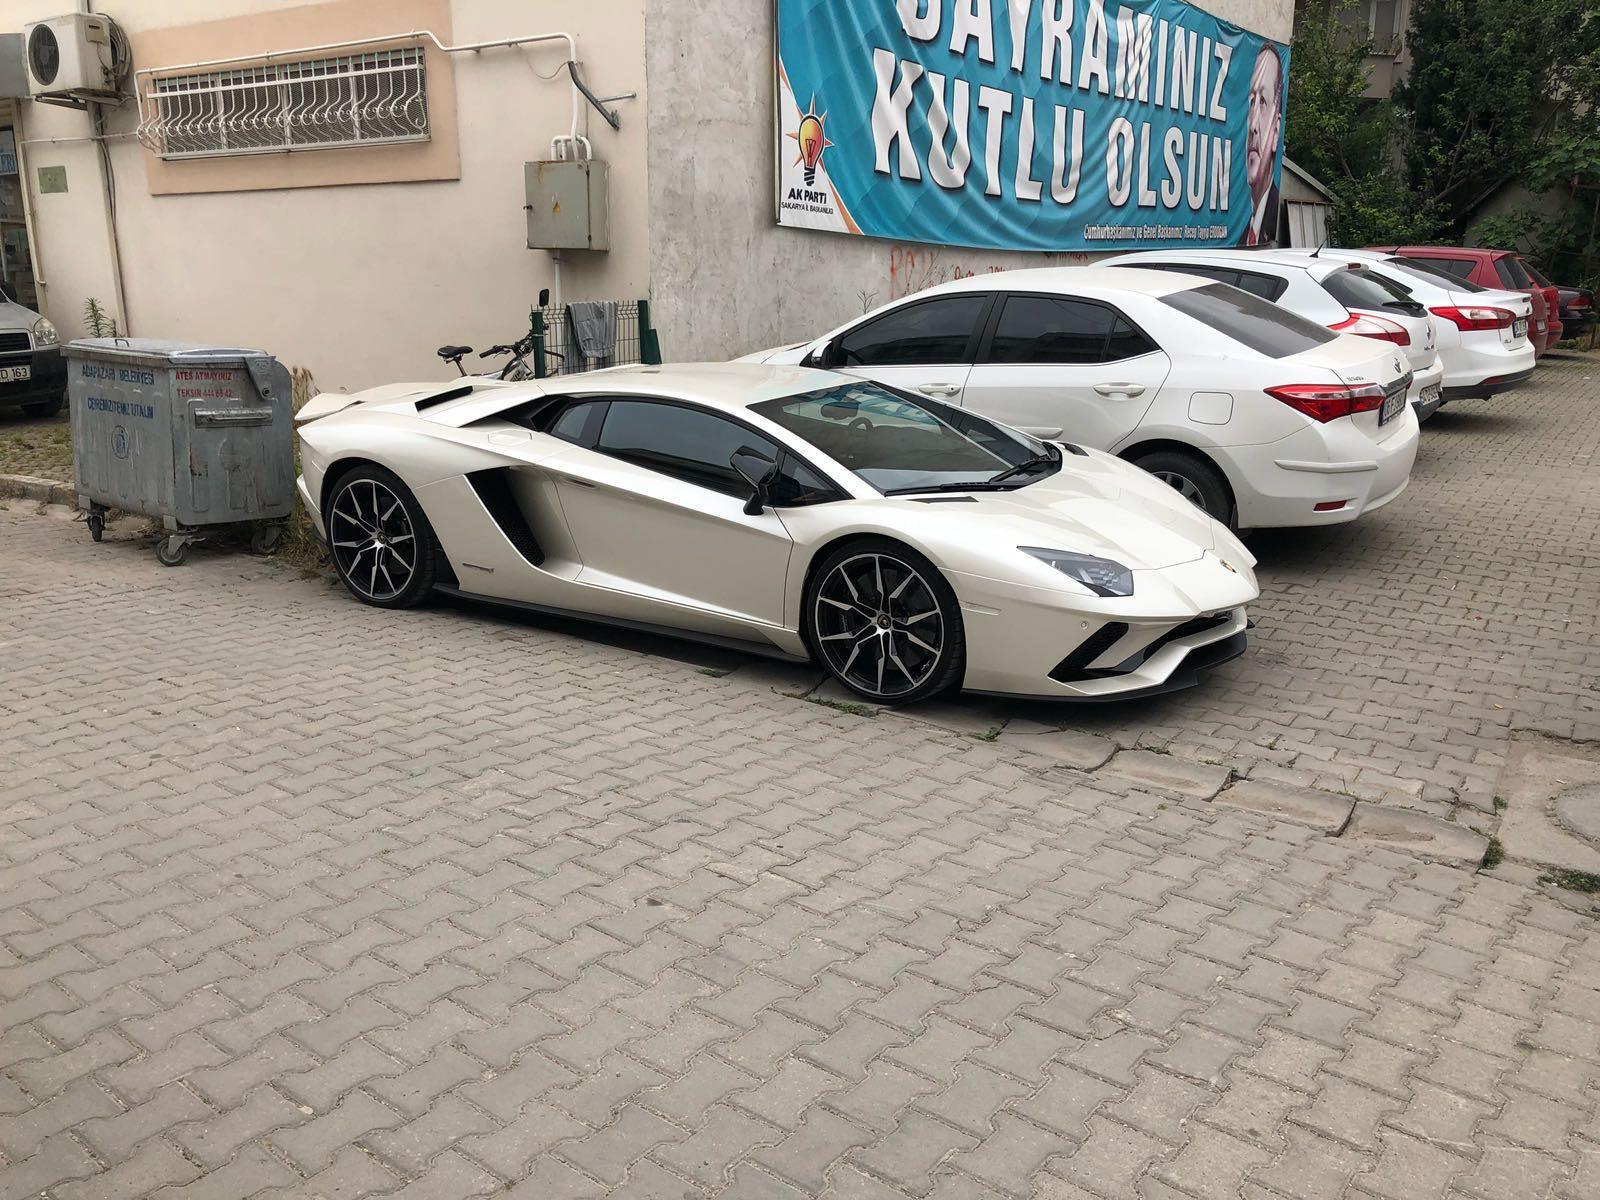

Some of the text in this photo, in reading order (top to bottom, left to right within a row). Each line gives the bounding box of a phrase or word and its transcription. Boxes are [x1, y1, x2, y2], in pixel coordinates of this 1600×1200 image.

[871, 47, 1086, 205] KUTLU
[1105, 115, 1233, 212] OLSUN
[788, 188, 803, 201] AK
[781, 201, 805, 211] SAKARYA
[1143, 224, 1158, 239] Genel
[12, 367, 28, 378] 163
